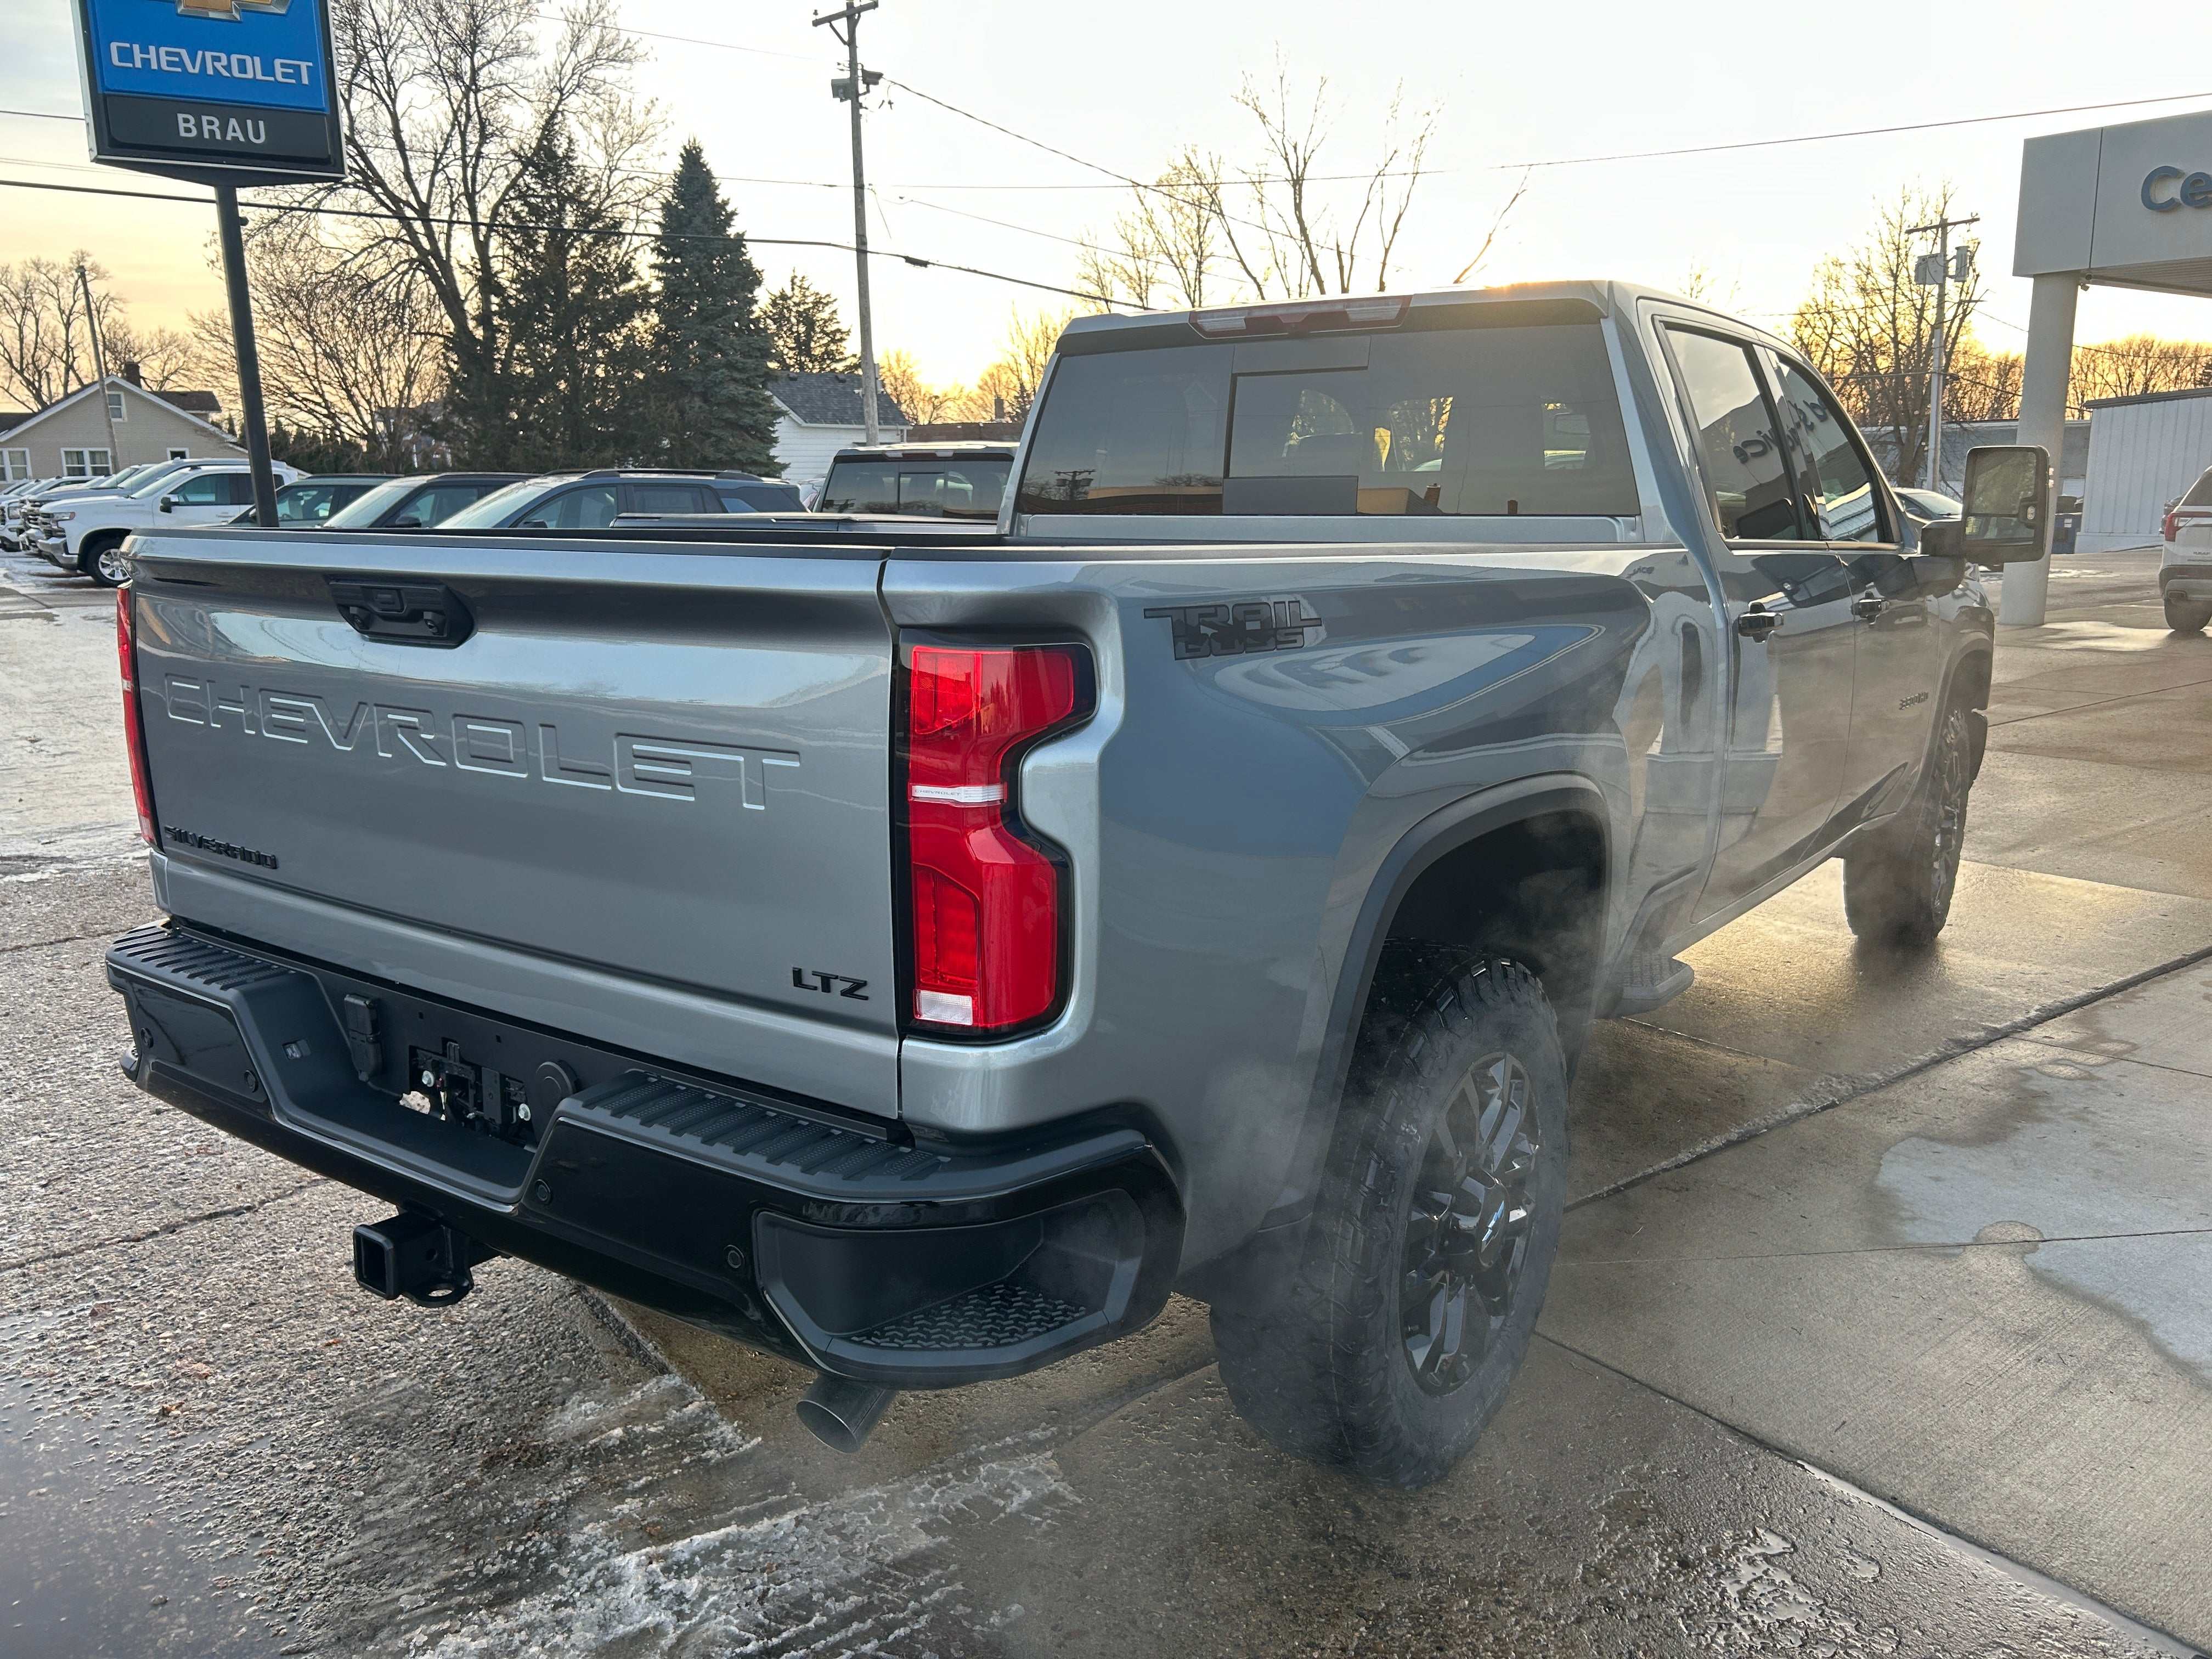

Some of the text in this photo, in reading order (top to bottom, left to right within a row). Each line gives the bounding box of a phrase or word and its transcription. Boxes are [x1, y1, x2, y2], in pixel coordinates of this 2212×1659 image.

[109, 42, 313, 85] CHEVROLET
[177, 113, 266, 144] BRAU
[1144, 600, 1322, 636] TRAIL
[165, 673, 801, 810] CHEVROLET
[164, 825, 278, 870] SILVERADO
[792, 966, 869, 1001] LTZ
